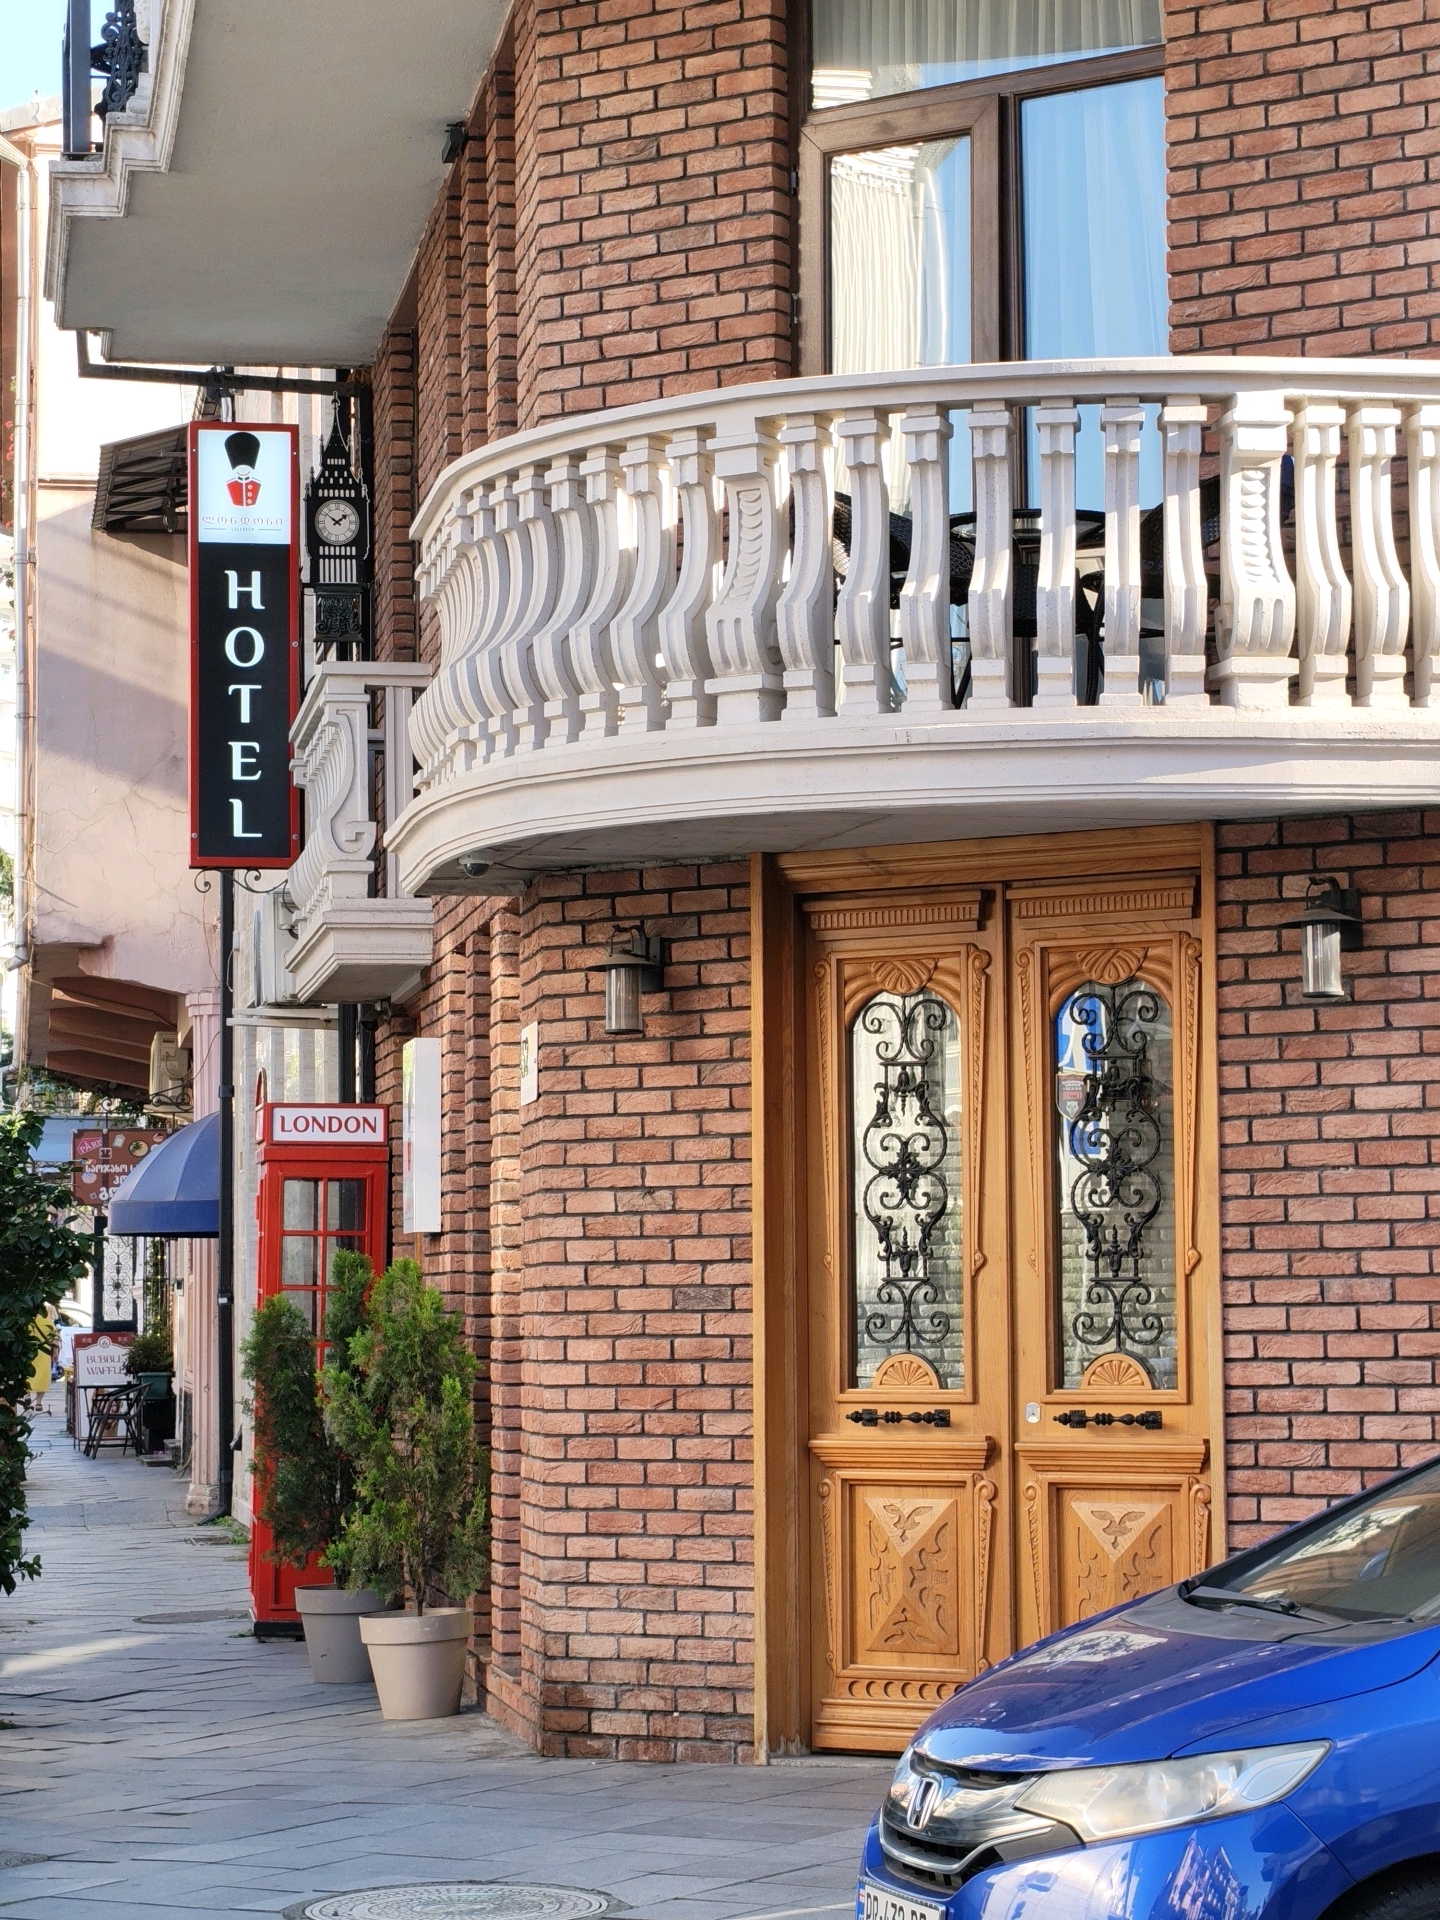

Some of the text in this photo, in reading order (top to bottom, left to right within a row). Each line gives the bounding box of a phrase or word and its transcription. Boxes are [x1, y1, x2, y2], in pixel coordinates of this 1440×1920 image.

[202, 516, 283, 526] ლონდონი
[224, 570, 265, 838] HOTEL
[279, 1115, 377, 1134] LONDON
